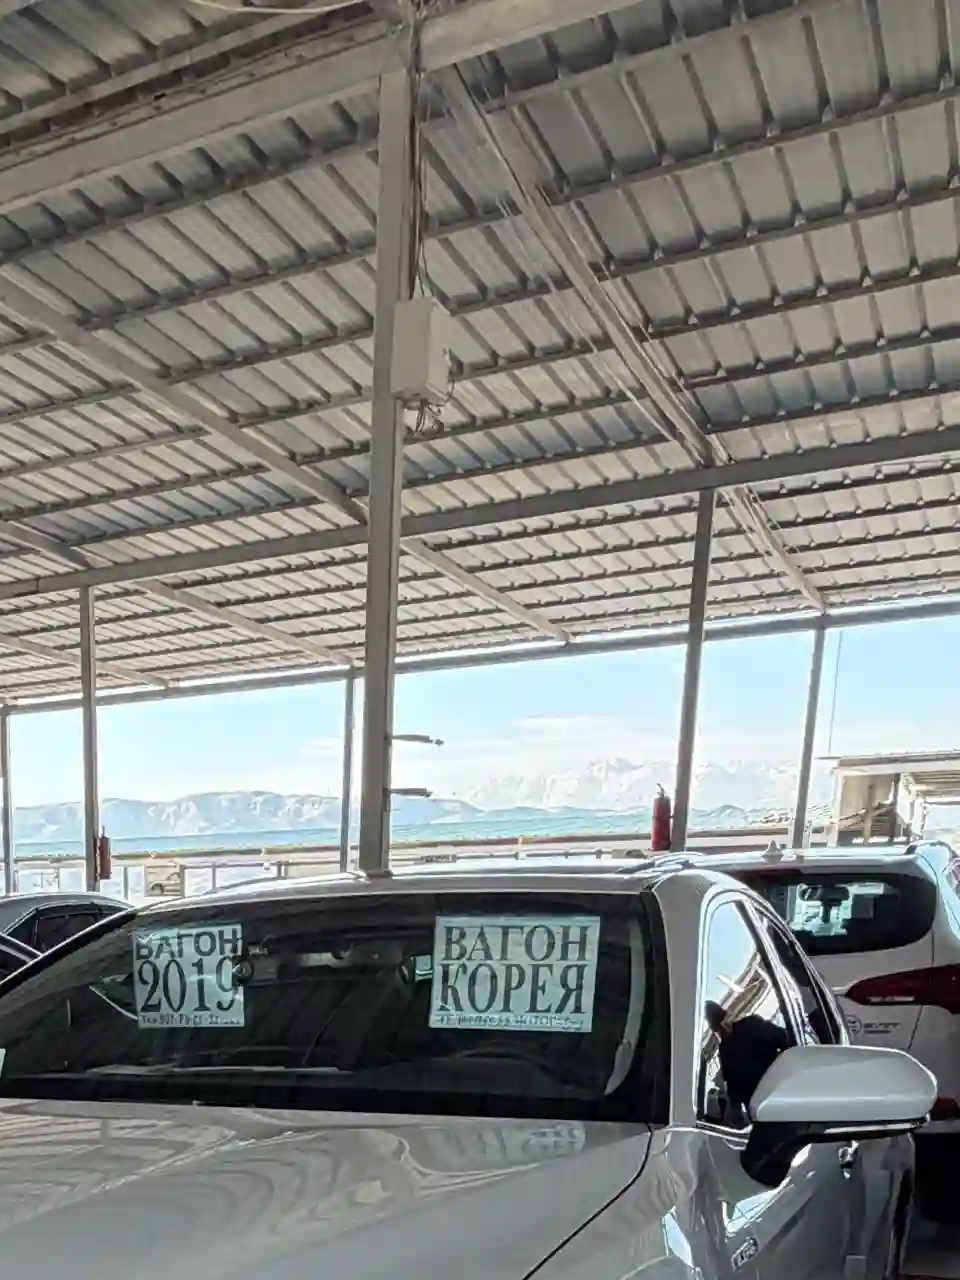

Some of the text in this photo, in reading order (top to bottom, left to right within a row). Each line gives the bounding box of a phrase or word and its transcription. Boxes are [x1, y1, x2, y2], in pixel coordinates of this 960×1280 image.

[136, 928, 239, 960] ВАГОН
[442, 924, 591, 961] ВАГОН
[138, 956, 236, 1012] 2019
[438, 963, 589, 1014] КОРЕЯ
